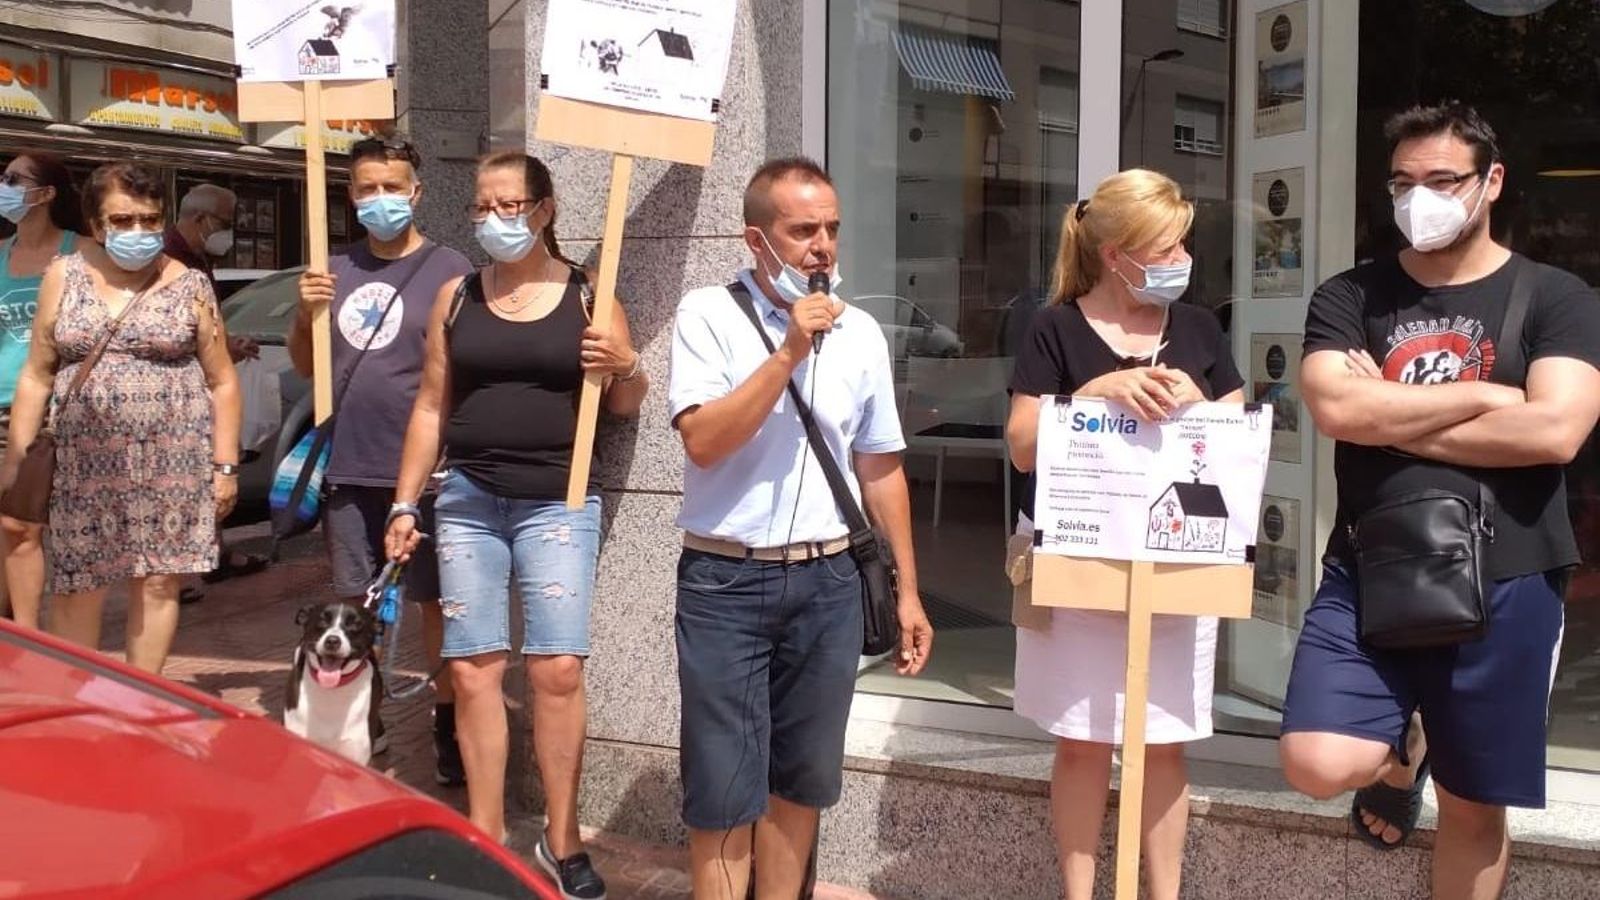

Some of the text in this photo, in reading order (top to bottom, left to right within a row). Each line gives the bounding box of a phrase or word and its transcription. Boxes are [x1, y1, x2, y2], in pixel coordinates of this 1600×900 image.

[0, 301, 39, 321] STO
[1071, 411, 1138, 434] Solvia
[1056, 519, 1101, 533] Solvia.es
